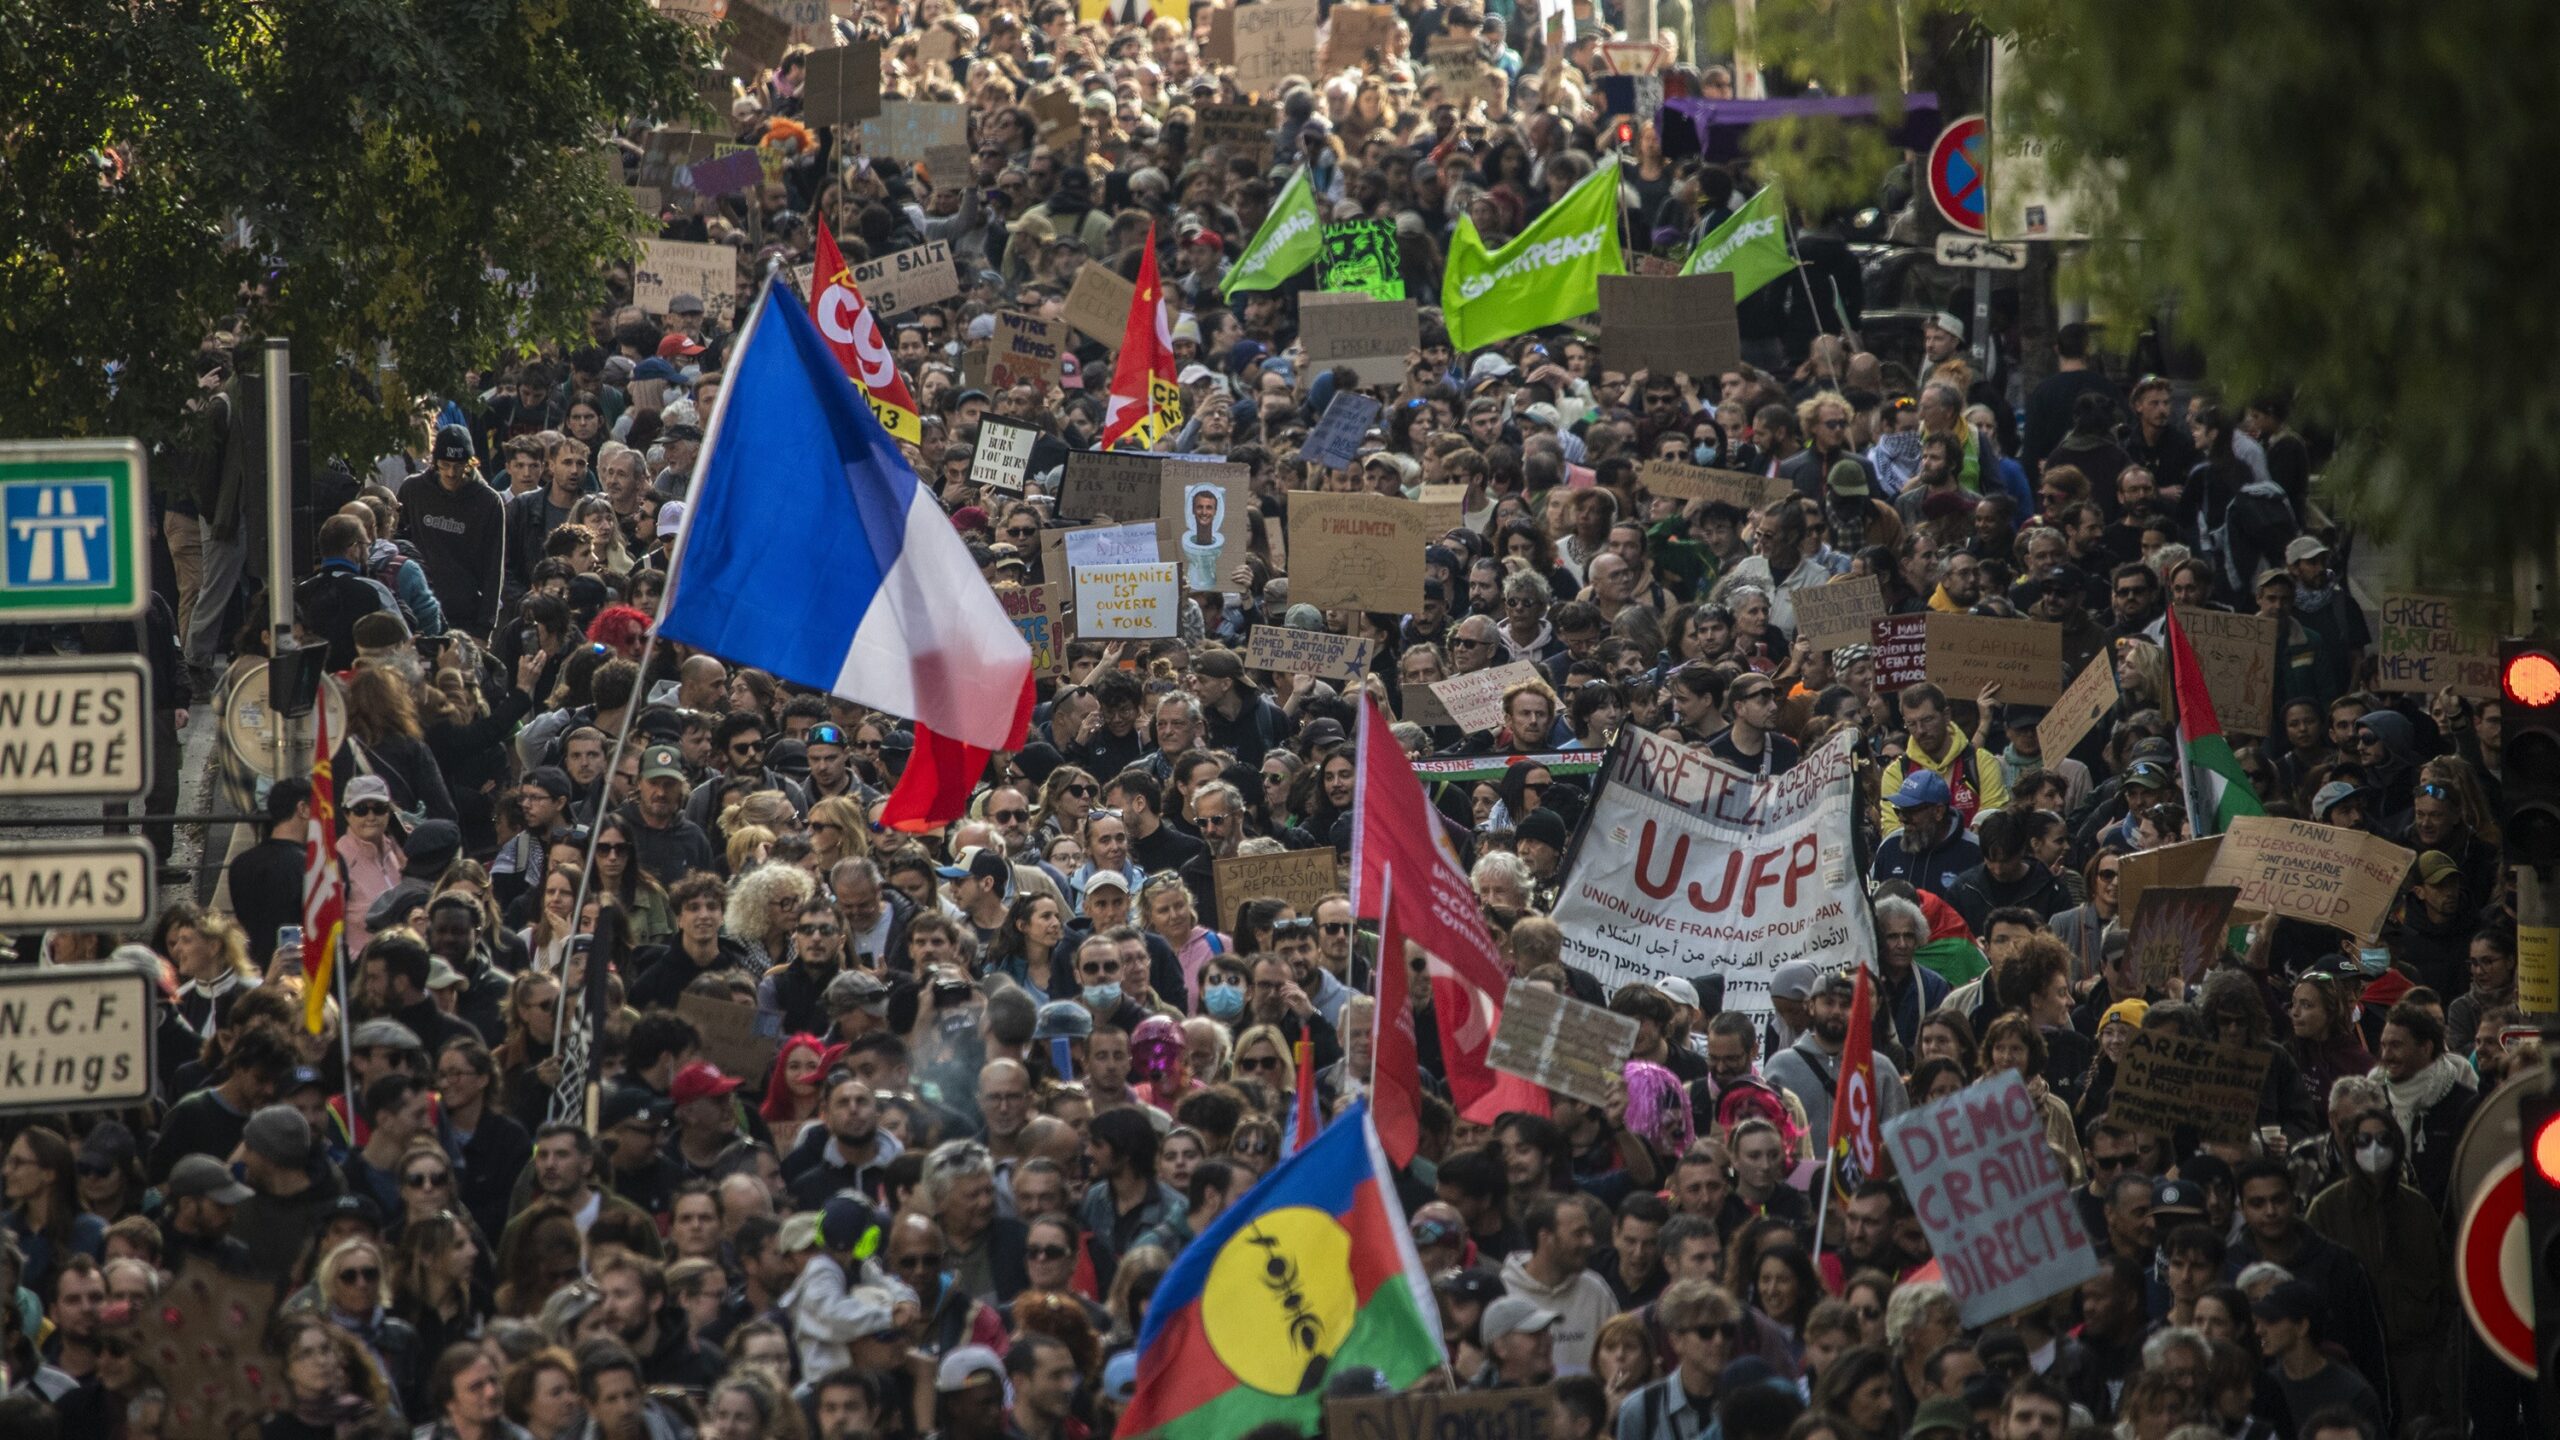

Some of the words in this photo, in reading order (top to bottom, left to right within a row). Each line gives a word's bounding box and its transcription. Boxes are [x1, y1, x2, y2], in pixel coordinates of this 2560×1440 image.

[988, 423, 999, 435] IF
[988, 437, 1014, 452] BURN
[981, 449, 1001, 463] YOU
[973, 465, 997, 481] WITH
[1114, 585, 1138, 598] EST
[1097, 598, 1156, 611] OUVERTE
[1287, 629, 1309, 640] SEND
[2184, 612, 2272, 645] JEUNESSE
[1252, 637, 1284, 649] ARMED
[1292, 641, 1345, 656] BATTALION
[1253, 647, 1263, 656] TO
[1270, 648, 1302, 660] REMIND
[1308, 652, 1325, 661] YOU
[1260, 659, 1276, 667] MY
[0, 688, 126, 728] NUES
[0, 730, 127, 778] NABÉ
[1410, 760, 1475, 772] ALESTINE
[2261, 837, 2295, 852] GENS
[2294, 843, 2315, 856] QUI
[2315, 847, 2333, 860] NE
[2333, 851, 2365, 868] SONT
[1227, 861, 1268, 880] STOP
[1293, 858, 1316, 869] LA
[1633, 819, 1818, 919] UJFP
[2257, 852, 2281, 864] SONT
[2283, 856, 2310, 870] DANS
[2310, 859, 2322, 871] LA
[2322, 861, 2345, 878] RUE
[0, 868, 130, 912] AMAS
[1242, 871, 1329, 891] REPRESSION
[2262, 867, 2280, 881] ET
[2281, 869, 2300, 886] ILS
[2302, 874, 2343, 894] SONT
[1582, 883, 1631, 917] UNION
[1630, 906, 1684, 932] JUIVE
[1680, 921, 1766, 943] FRANÇAISE
[1767, 917, 1808, 938] POUR
[1815, 901, 1844, 922] PAIX
[1561, 935, 1611, 963] השלום
[1645, 938, 1679, 958] أجل
[1681, 949, 1706, 964] من
[4, 1048, 132, 1093] kings
[1899, 1083, 2035, 1175] DEMO
[1917, 1131, 2059, 1232] CRATIE
[1942, 1189, 2088, 1300] DIRECTE
